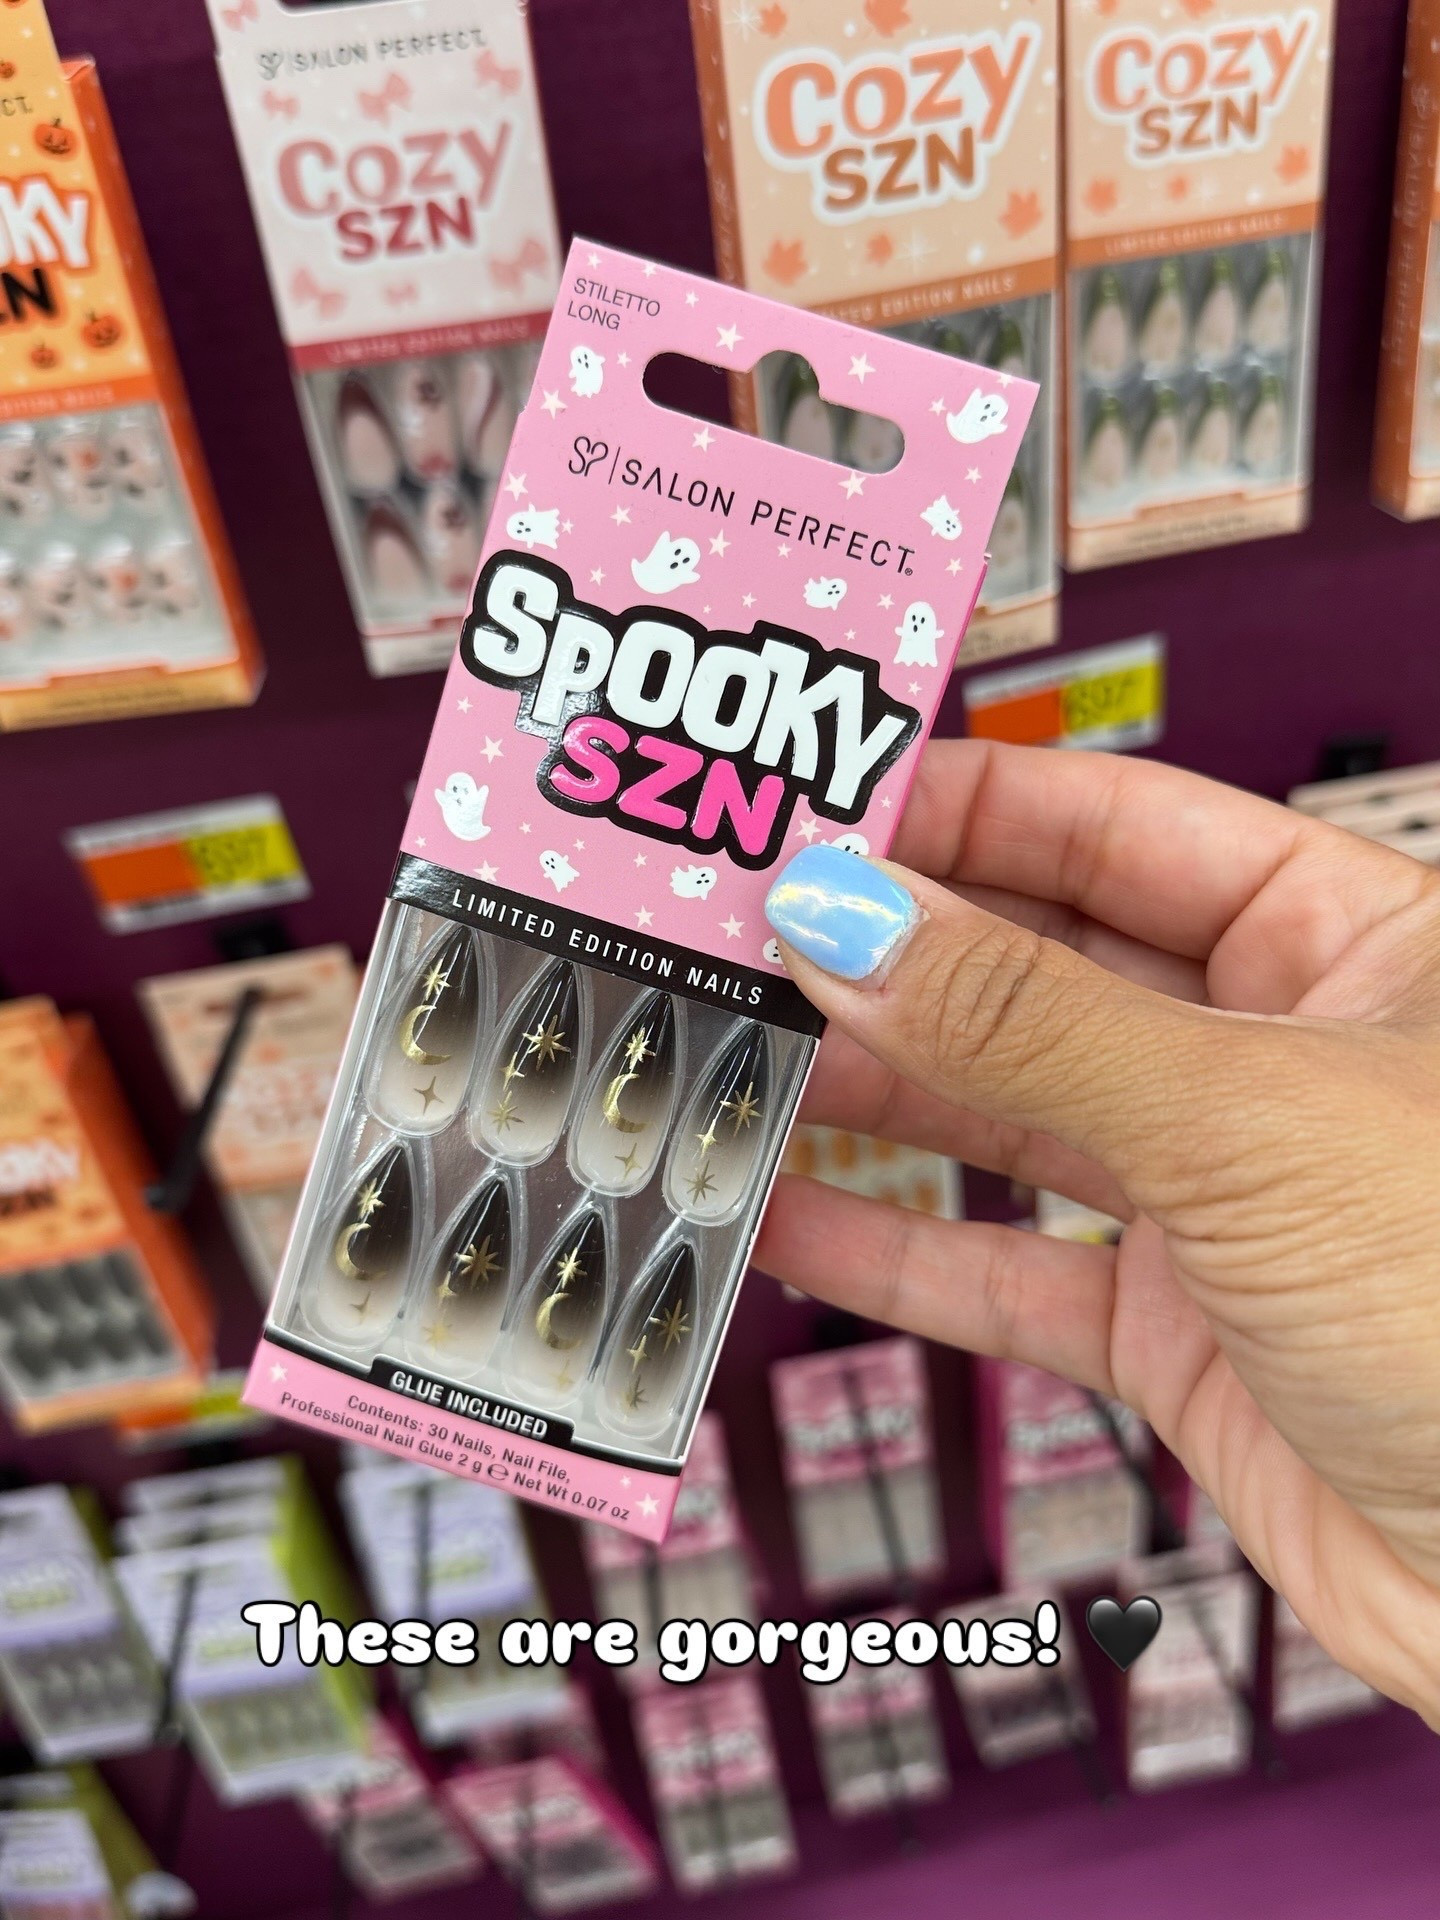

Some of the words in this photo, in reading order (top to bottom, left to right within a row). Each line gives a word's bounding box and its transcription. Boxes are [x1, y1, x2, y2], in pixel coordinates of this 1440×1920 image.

[766, 35, 1030, 159] COZY
[1095, 20, 1308, 114] COZY
[277, 120, 512, 219] COZY
[824, 126, 975, 213] SZN
[1136, 92, 1258, 157] SZN
[335, 196, 476, 262] SZN
[567, 300, 621, 330] LONG
[574, 277, 661, 317] STILETTO
[621, 459, 735, 517] SALON
[750, 500, 915, 573] PERFECT
[473, 565, 906, 810] SPOOKY
[549, 715, 785, 856] SZN
[452, 888, 556, 939] LIMITED
[569, 929, 674, 978] EDITION
[686, 967, 763, 1005] NAILS
[348, 1395, 423, 1432] Contents:
[428, 1423, 448, 1440] 30
[453, 1432, 496, 1459] Nails,
[503, 1448, 535, 1469] Nail
[538, 1460, 571, 1484] File,
[390, 1371, 444, 1403] GLUE
[447, 1390, 548, 1439] INCLUDED
[280, 1392, 379, 1436] Professional
[383, 1427, 414, 1448] Nail
[418, 1440, 453, 1462] Glue
[458, 1454, 469, 1466] 2
[472, 1461, 483, 1474] g
[514, 1472, 541, 1491] Net
[548, 1485, 568, 1501] Wt
[572, 1491, 608, 1512] 0.07
[611, 1506, 630, 1520] oz
